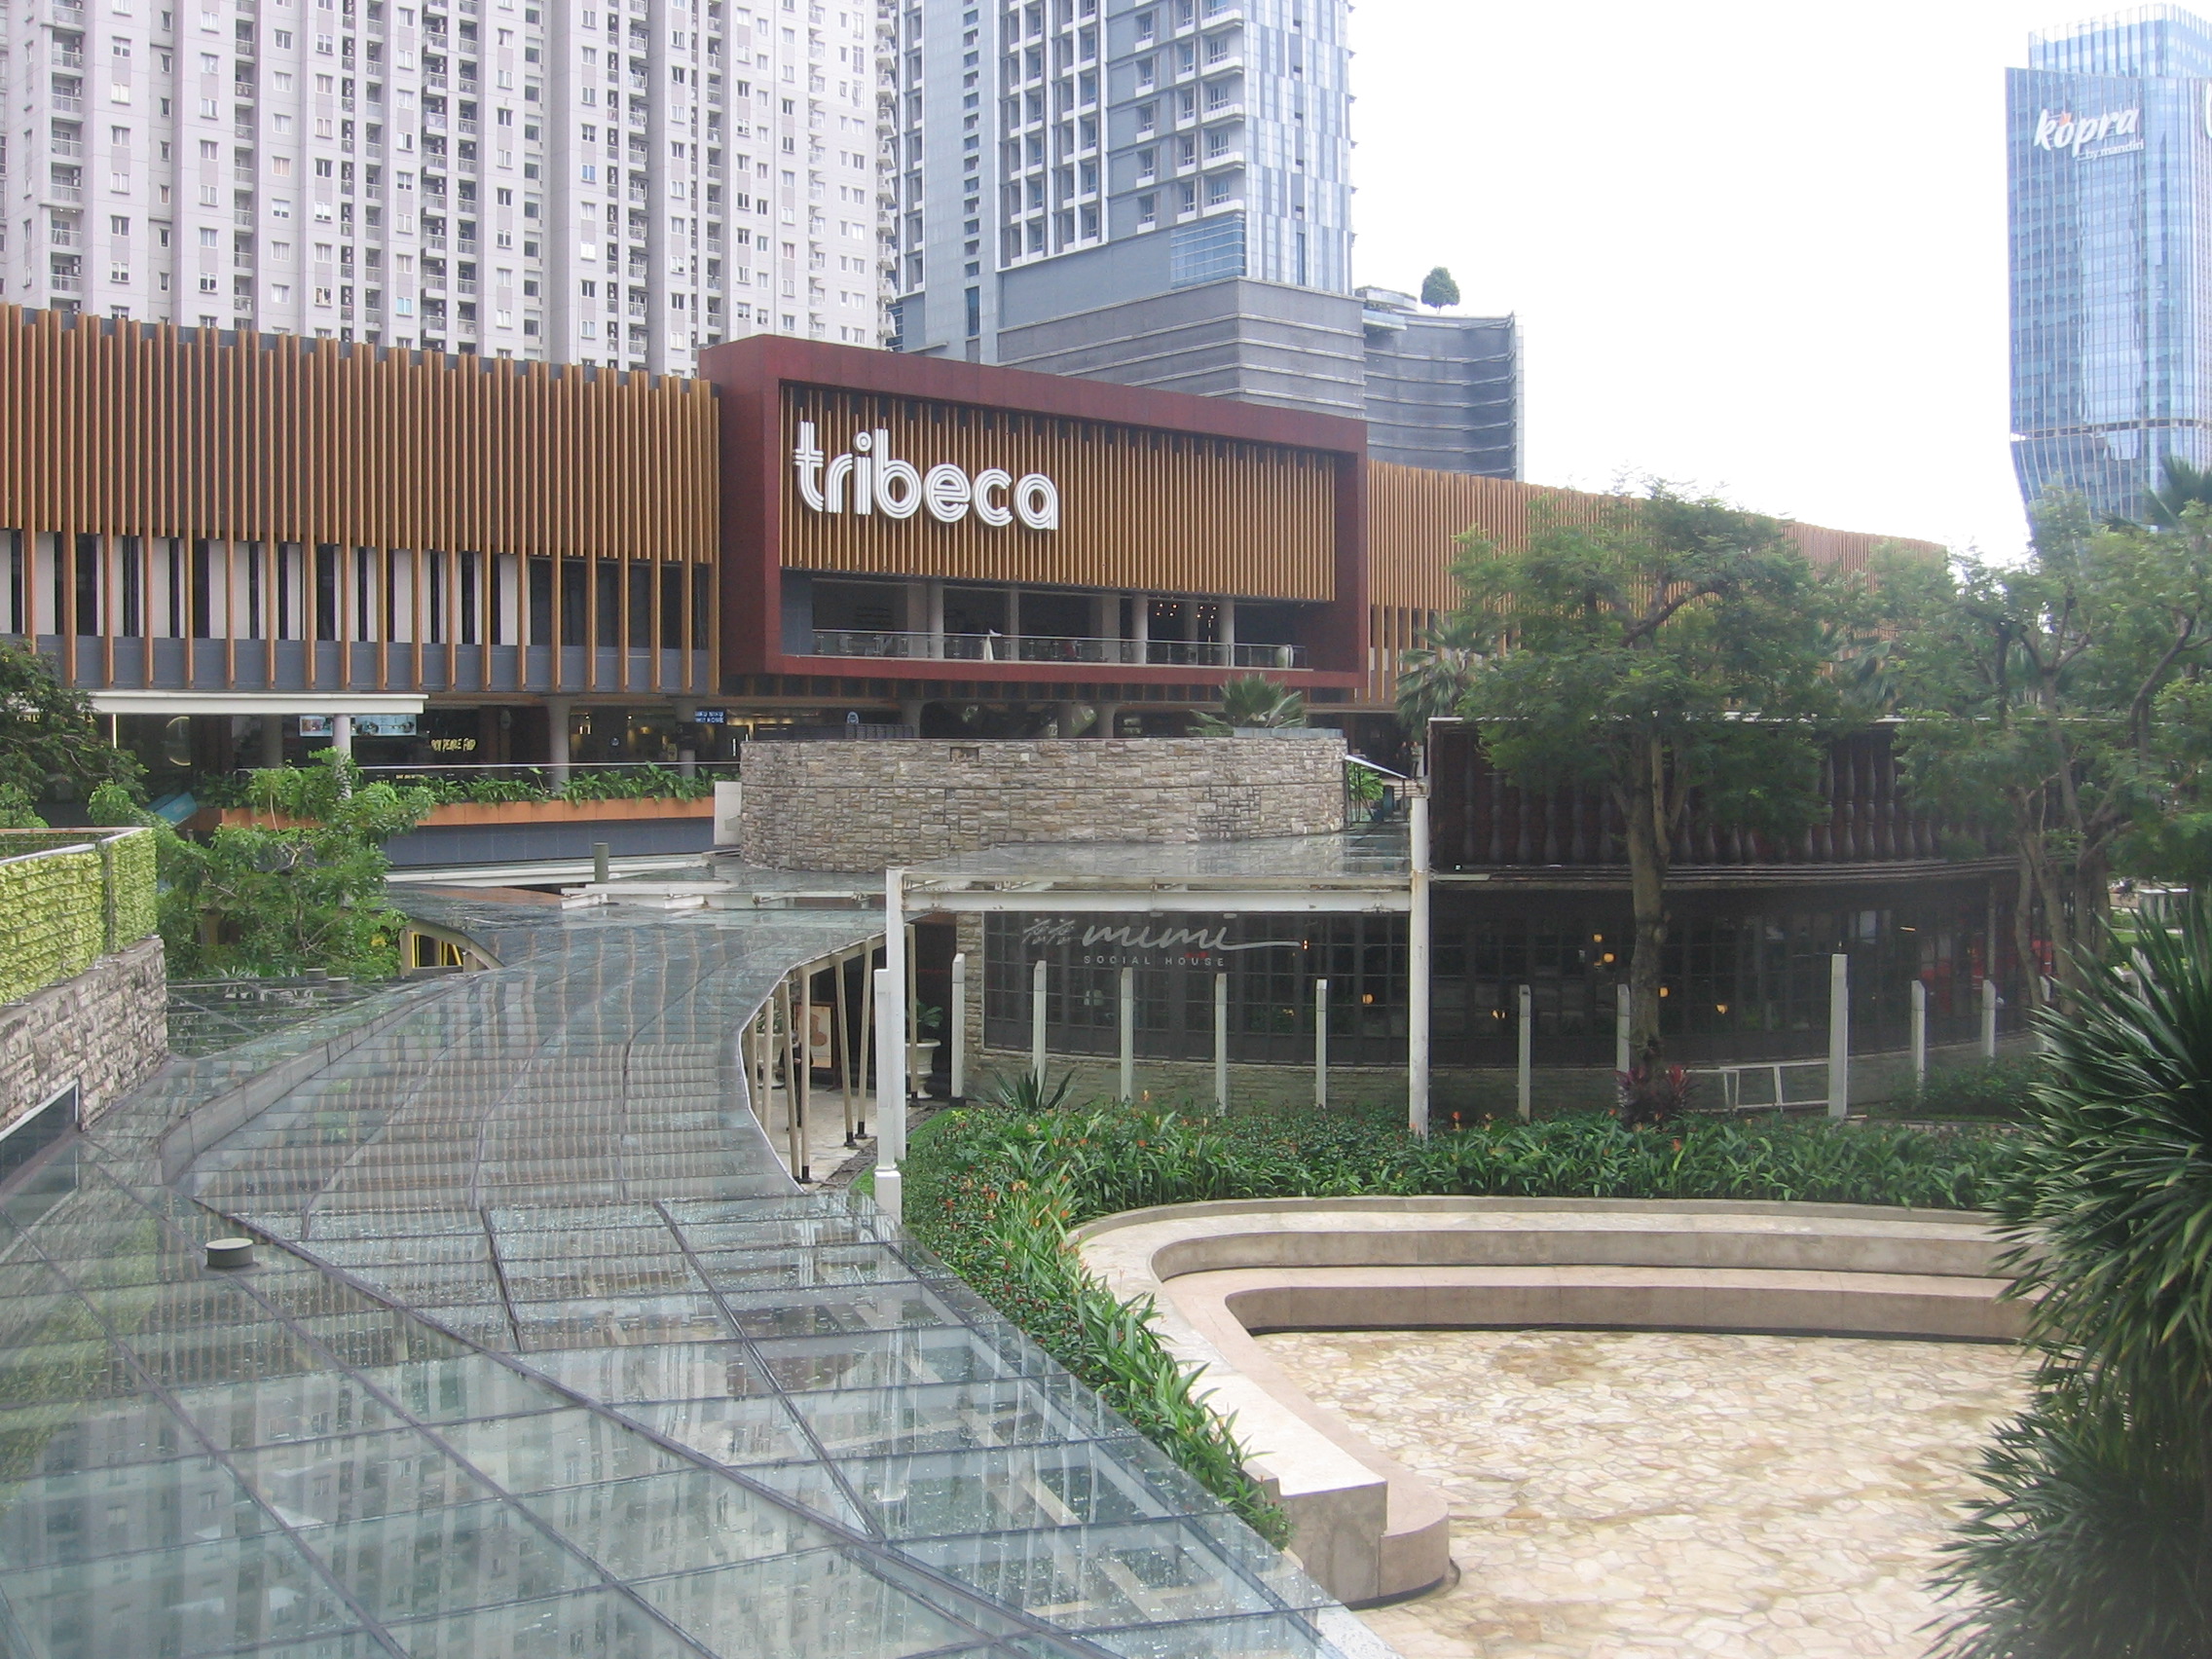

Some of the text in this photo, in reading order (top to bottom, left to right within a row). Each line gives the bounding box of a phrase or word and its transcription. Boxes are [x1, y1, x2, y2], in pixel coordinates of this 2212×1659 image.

[2033, 108, 2140, 158] kopra
[2084, 138, 2145, 161] by mandiri
[793, 420, 1059, 531] tribeca
[1082, 925, 1302, 951] mimi
[1083, 955, 1225, 967] SOCIAL HOUSE
